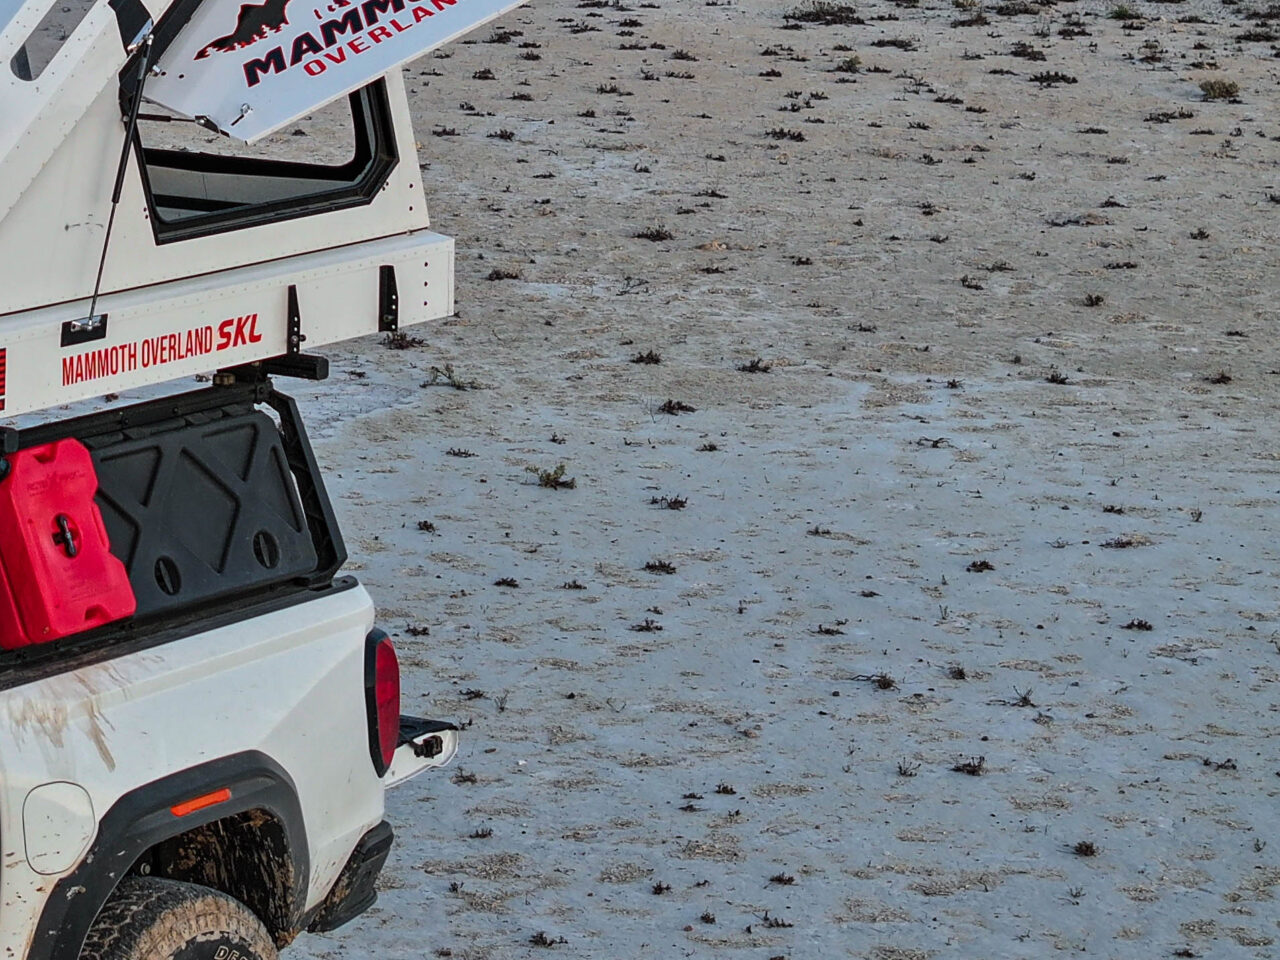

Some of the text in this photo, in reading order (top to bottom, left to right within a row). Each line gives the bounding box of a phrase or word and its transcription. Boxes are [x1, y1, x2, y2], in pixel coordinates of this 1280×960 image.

[61, 313, 263, 387] MAMMOTH OVERLAND SKL
